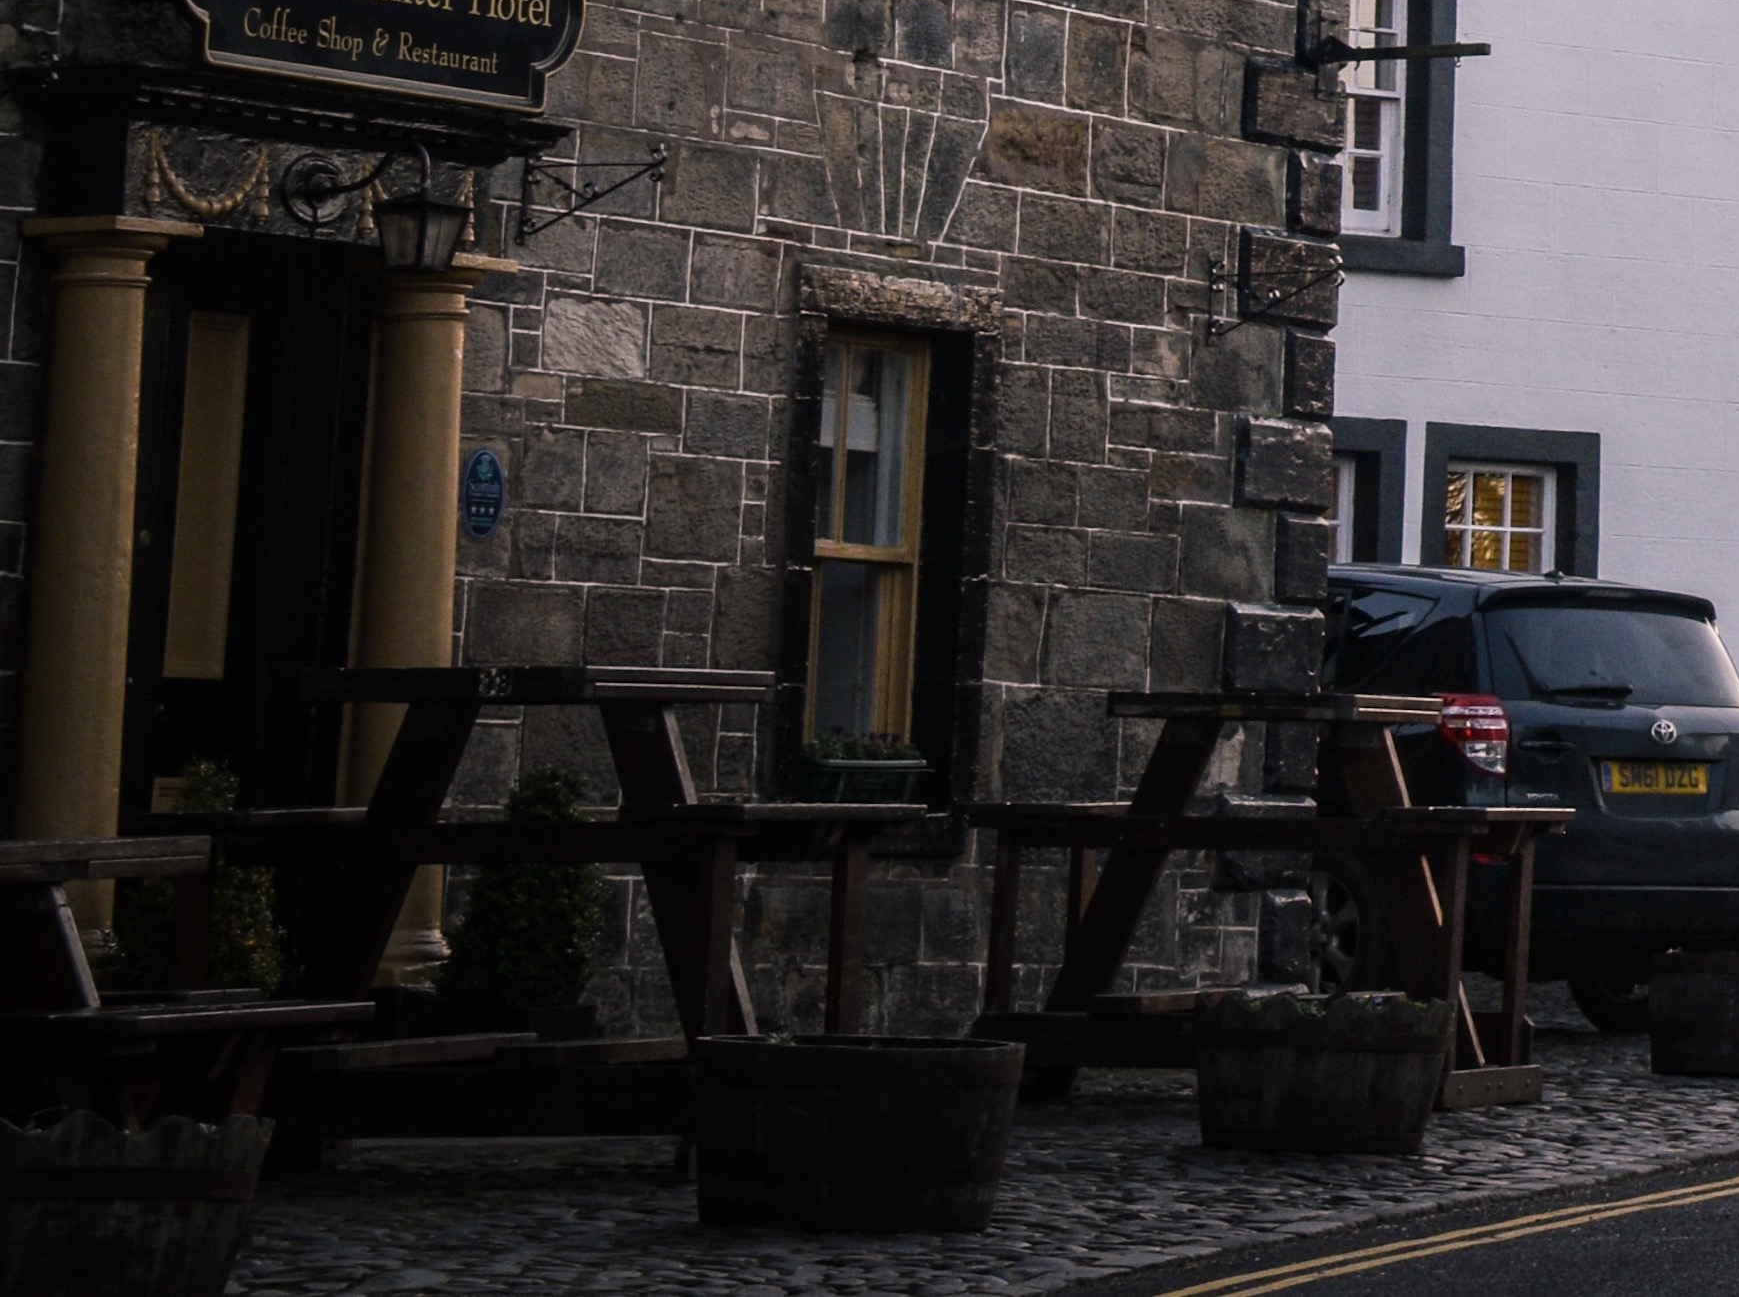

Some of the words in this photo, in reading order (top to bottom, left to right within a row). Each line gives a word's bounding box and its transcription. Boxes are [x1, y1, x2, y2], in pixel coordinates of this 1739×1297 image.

[243, 7, 308, 46] Coffee
[316, 15, 365, 62] Shop
[372, 28, 390, 57] &
[398, 32, 500, 75] Restaurant
[1664, 766, 1700, 789] DZG
